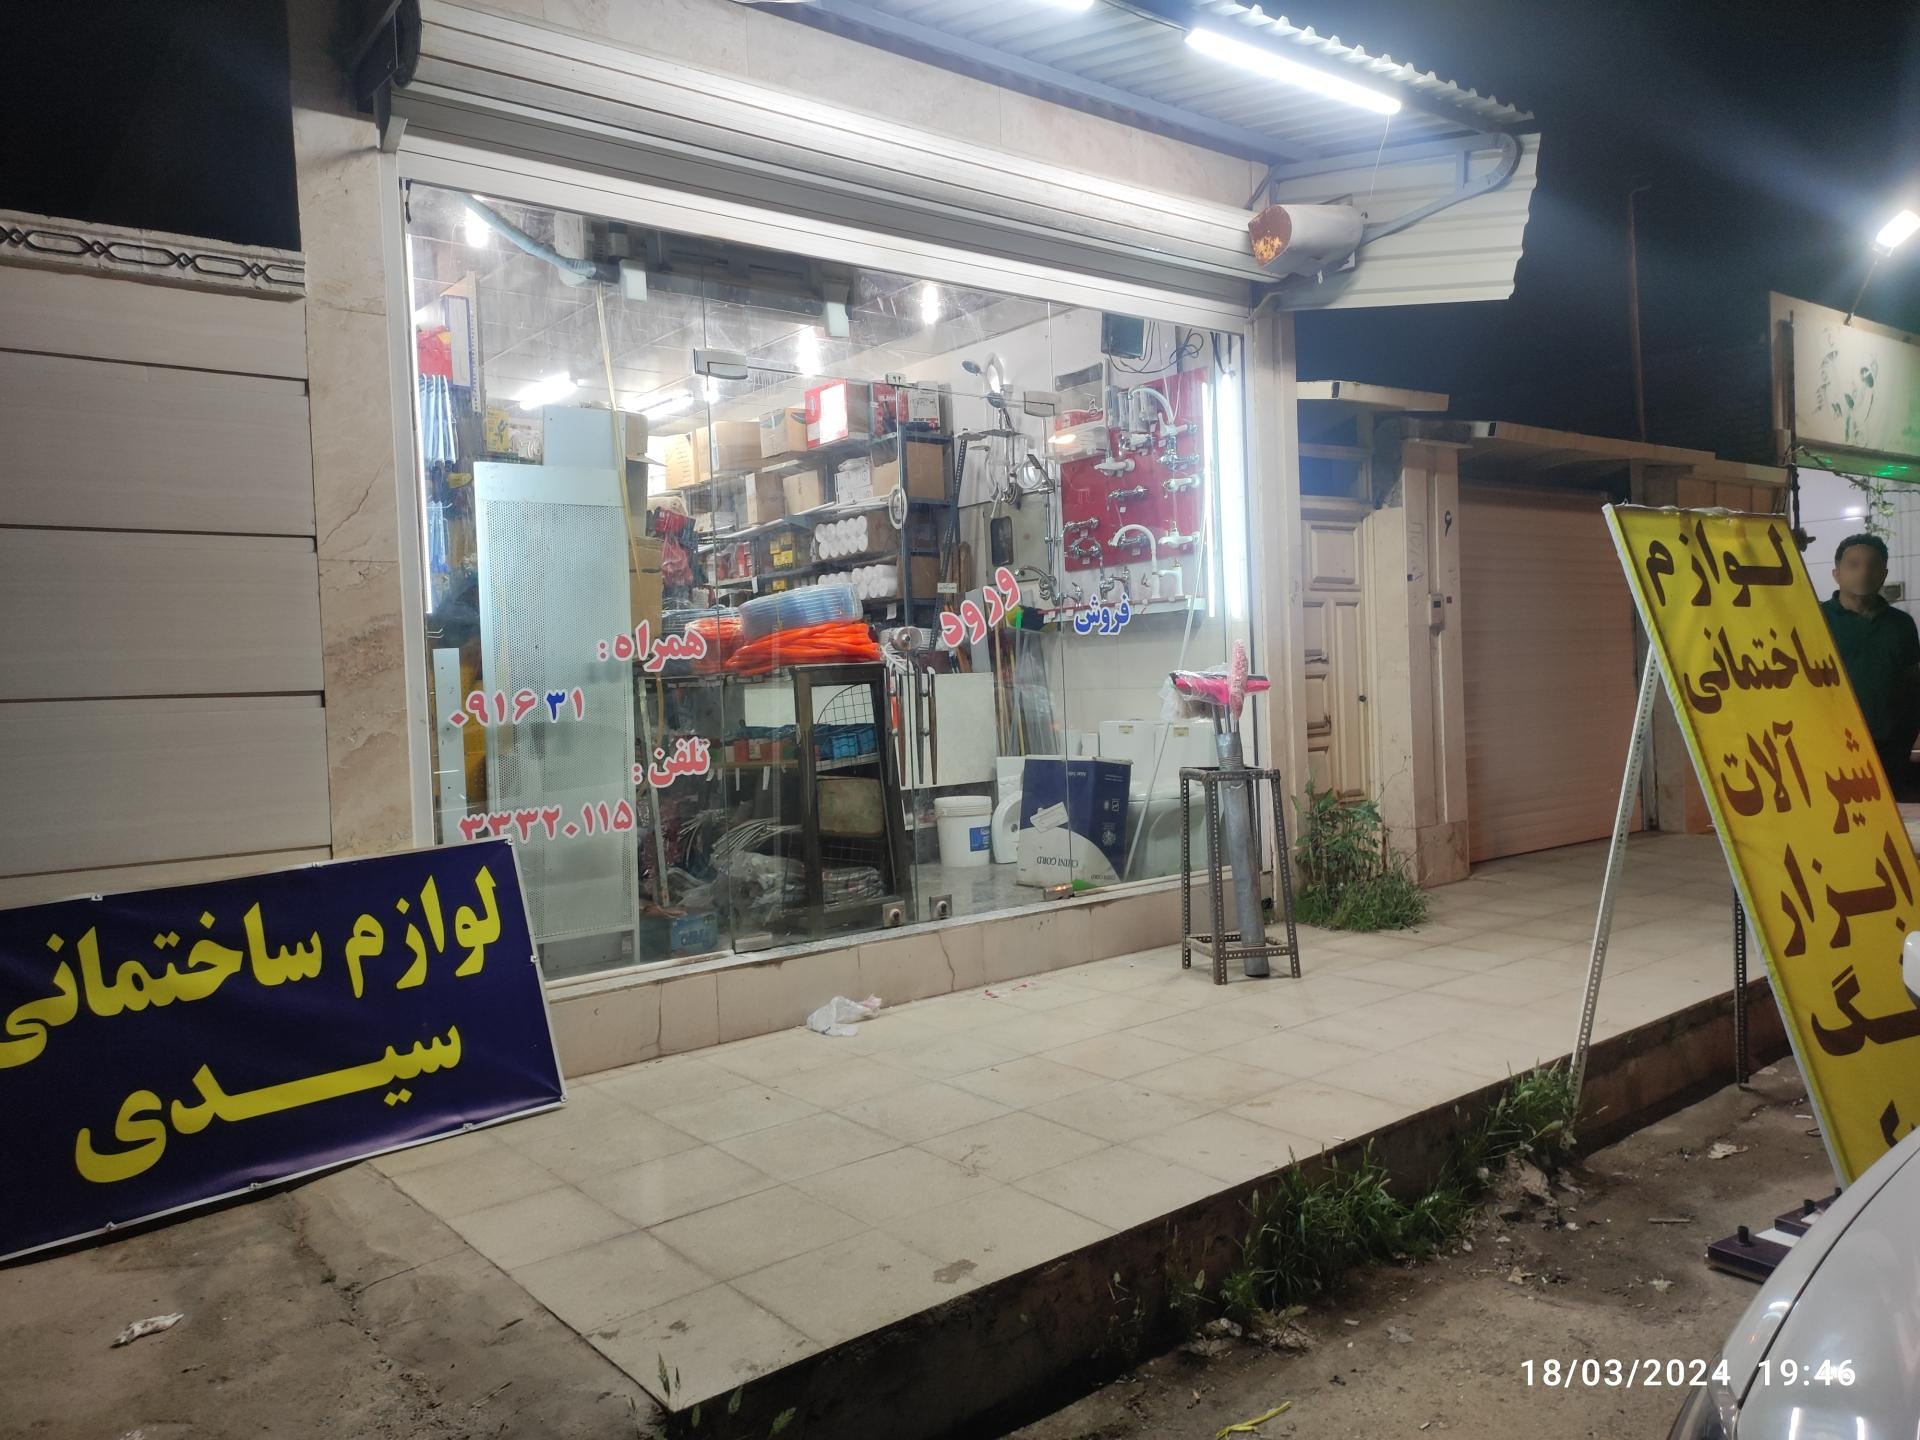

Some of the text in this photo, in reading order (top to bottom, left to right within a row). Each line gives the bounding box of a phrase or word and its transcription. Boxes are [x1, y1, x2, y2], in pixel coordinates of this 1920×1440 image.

[939, 566, 1022, 648] ورود
[1073, 592, 1131, 636] فروش
[1646, 520, 1794, 607] لوازم
[1684, 626, 1841, 714] ساختمانی
[1720, 720, 1881, 834] شیر آلات
[1780, 831, 1914, 958] ابزار
[0, 865, 502, 1070] لوازم ساختمانی
[75, 1024, 463, 1184] سیدی
